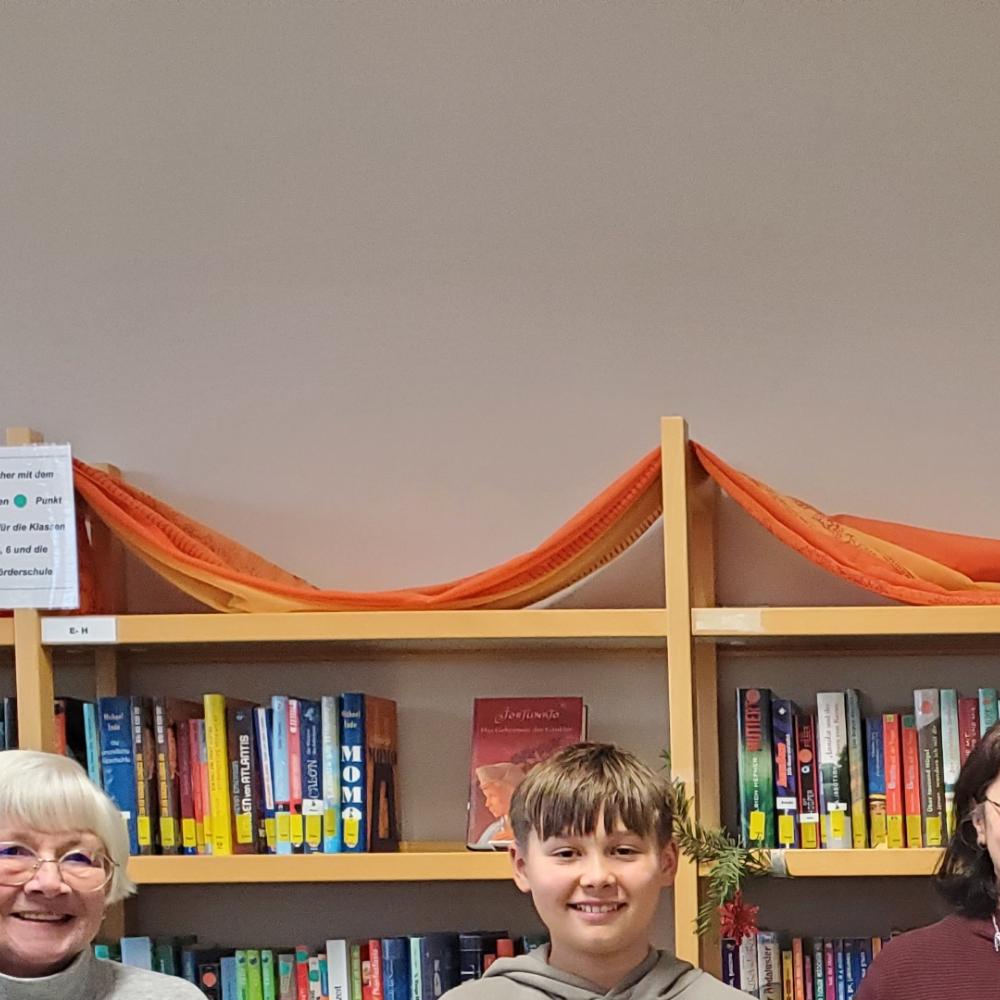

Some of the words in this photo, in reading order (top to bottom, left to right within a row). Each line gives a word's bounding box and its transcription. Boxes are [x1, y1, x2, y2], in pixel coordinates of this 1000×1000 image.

[0, 471, 16, 480] her
[18, 470, 32, 479] mit
[34, 470, 54, 479] dem
[35, 496, 62, 505] Punkt
[12, 523, 28, 532] die
[5, 545, 11, 554] 6
[13, 544, 32, 554] und
[33, 544, 48, 554] die
[69, 627, 79, 635] E-
[81, 627, 89, 635] H
[239, 735, 251, 784] ATLANTIS
[763, 945, 773, 994] Andalusier
